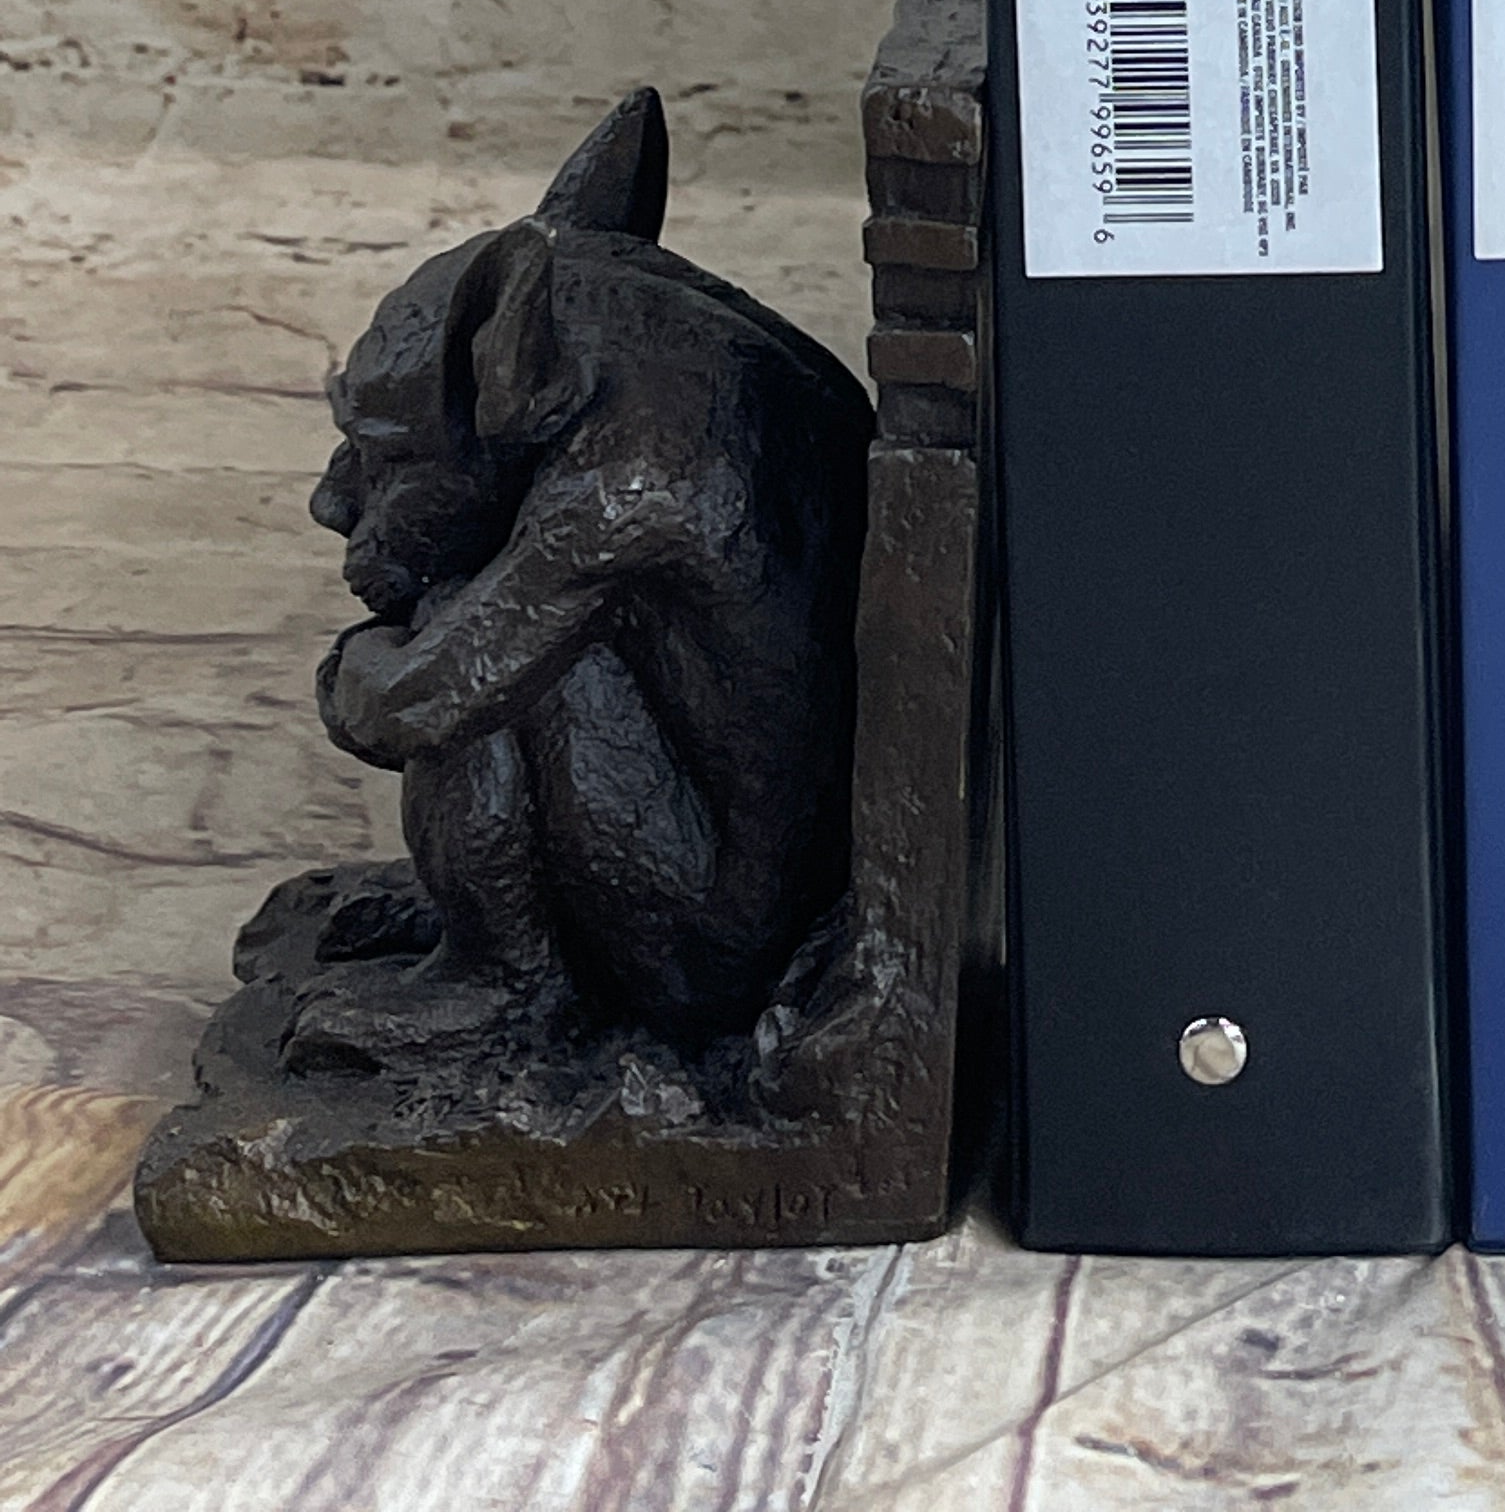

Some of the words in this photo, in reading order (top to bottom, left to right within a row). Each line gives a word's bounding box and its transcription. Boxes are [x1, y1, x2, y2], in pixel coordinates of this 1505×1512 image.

[1086, 2, 1111, 90] 39277
[1090, 106, 1114, 194] 99659
[1093, 229, 1115, 244] 6
